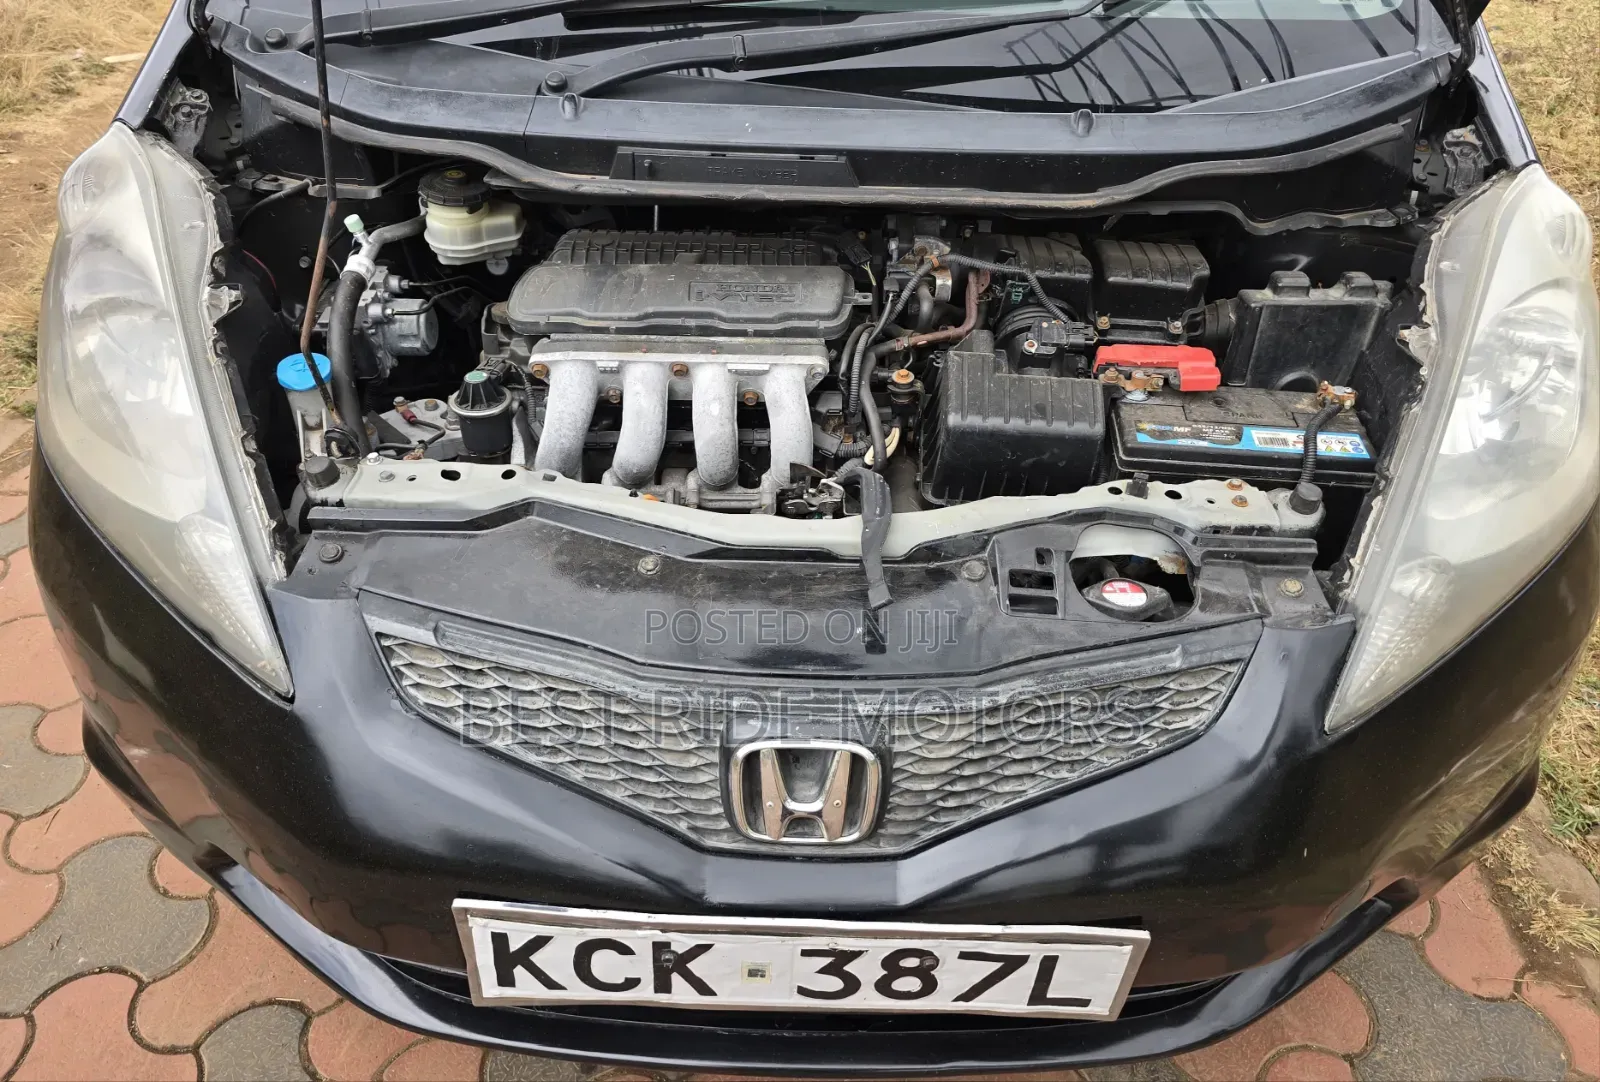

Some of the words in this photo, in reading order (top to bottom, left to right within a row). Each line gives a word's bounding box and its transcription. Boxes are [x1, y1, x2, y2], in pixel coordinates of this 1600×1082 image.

[715, 284, 789, 294] HONDA
[490, 930, 720, 998] KCK
[796, 946, 1093, 1008] 387L
